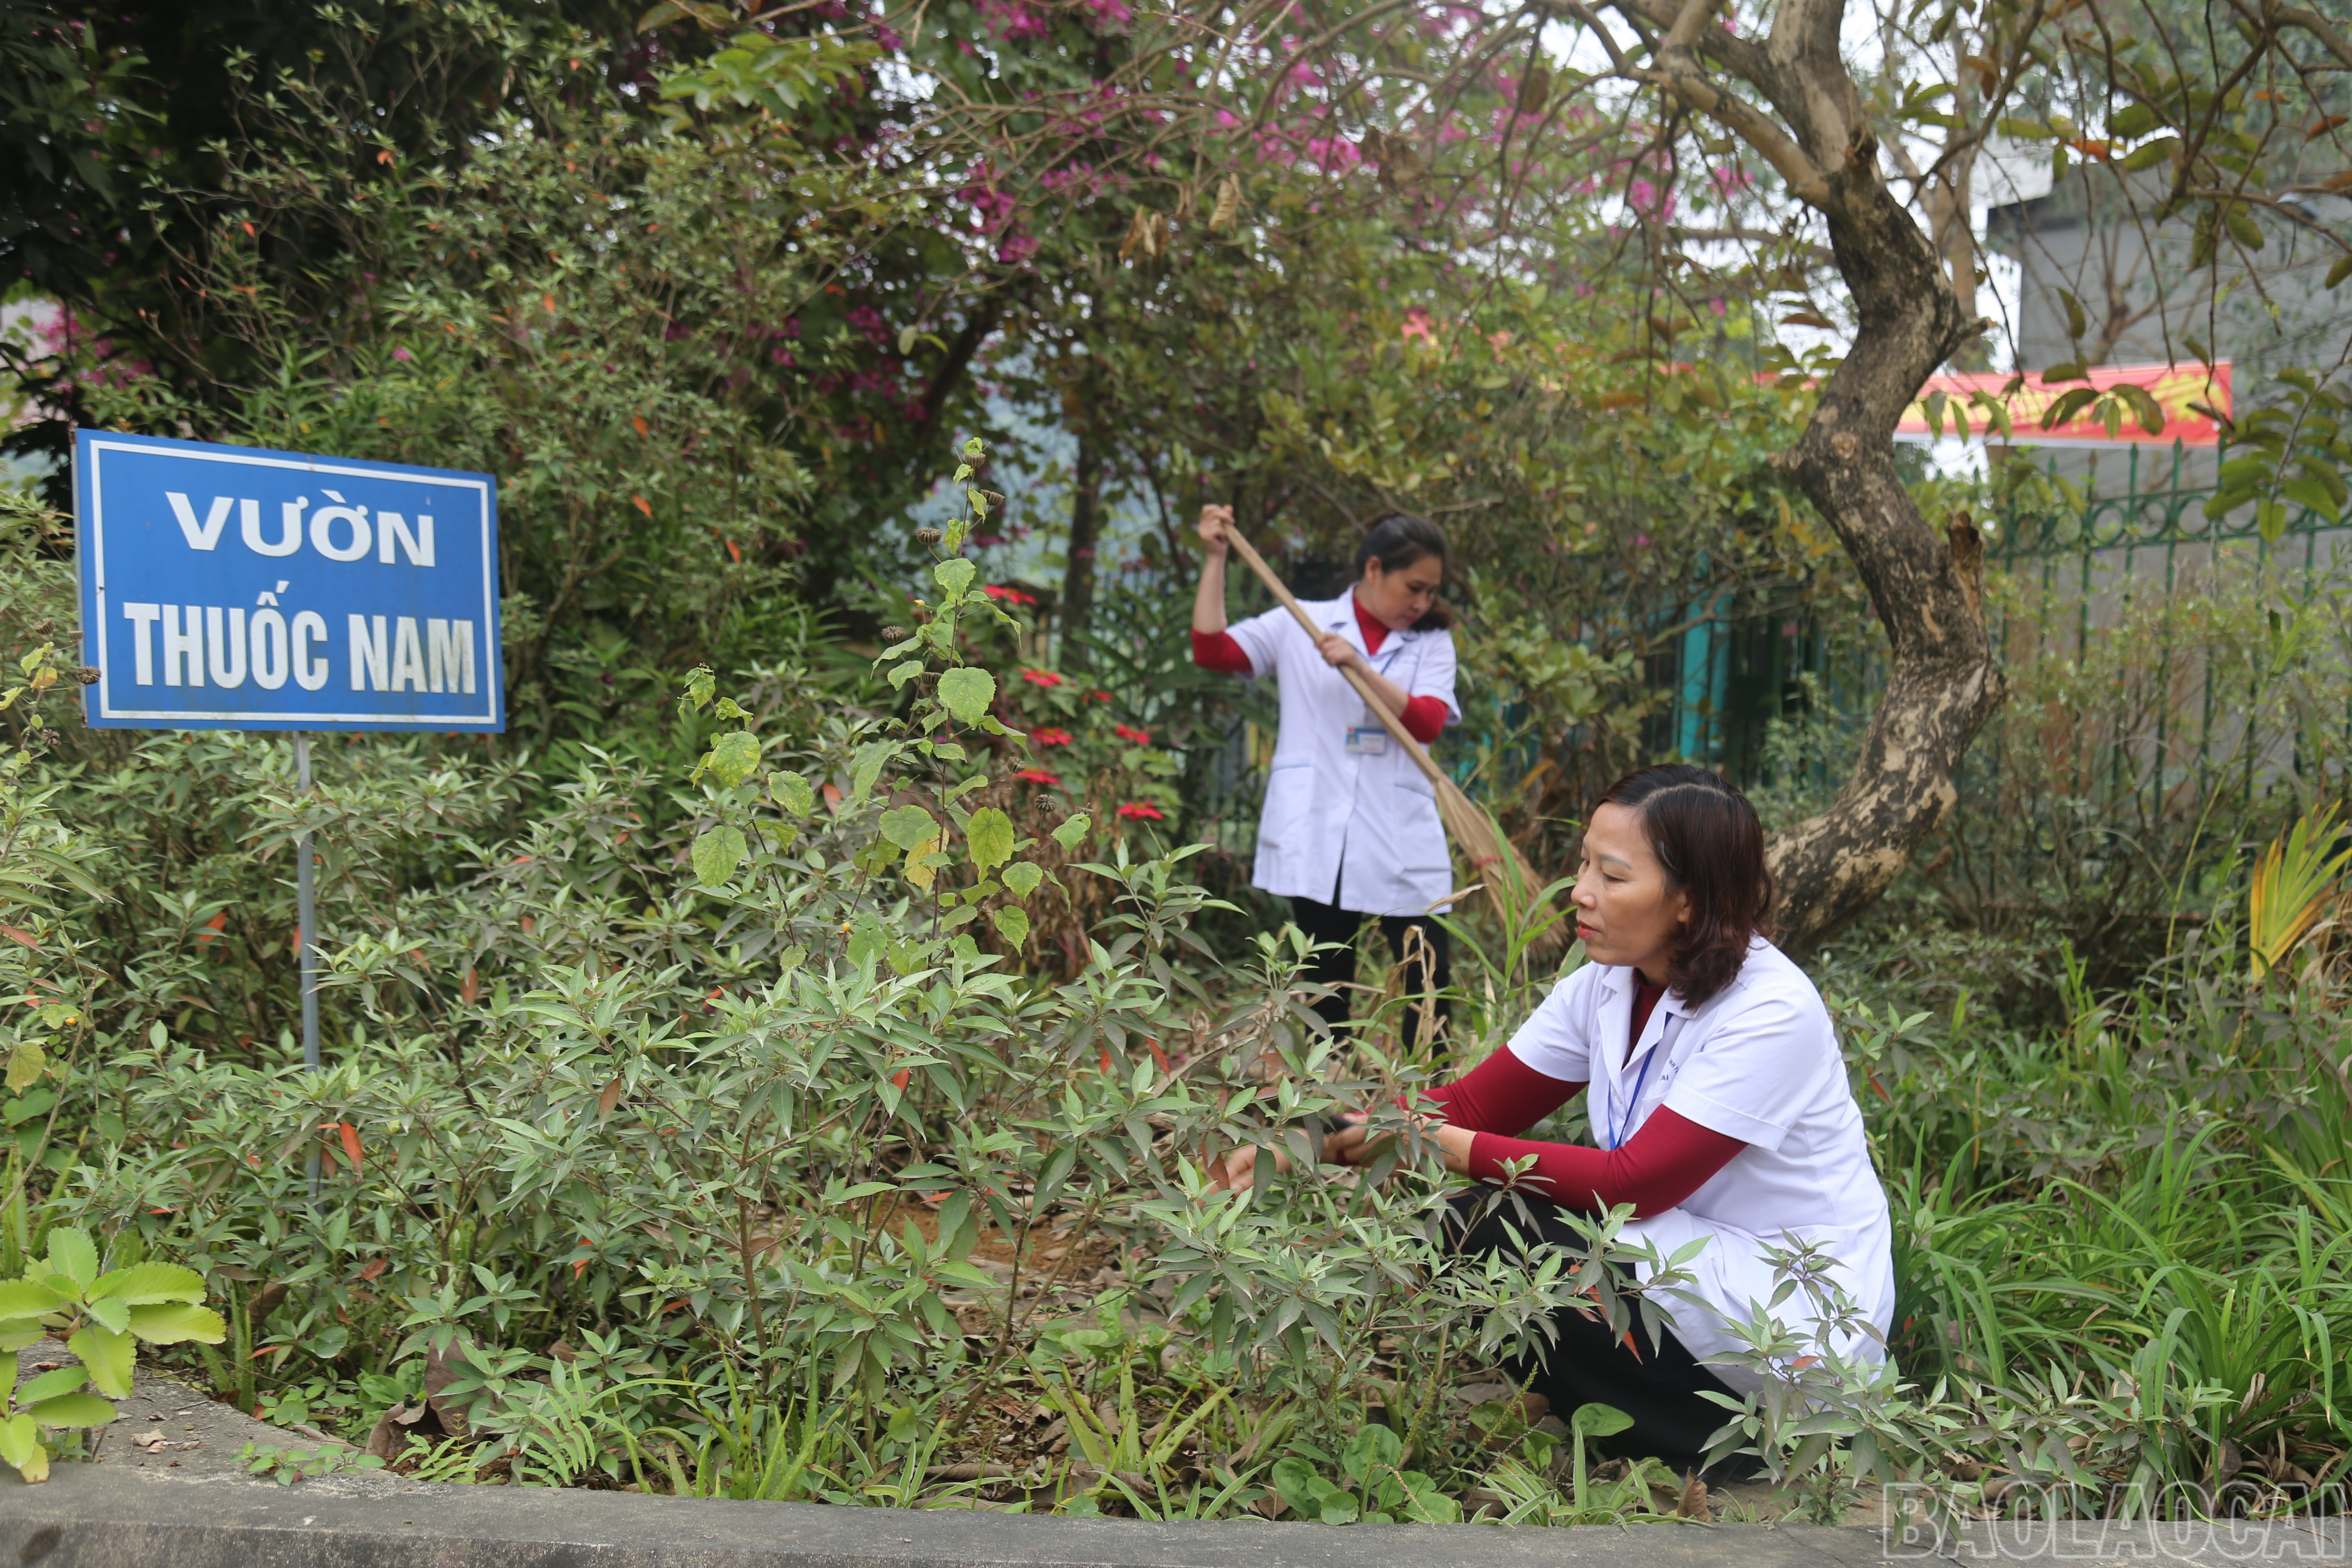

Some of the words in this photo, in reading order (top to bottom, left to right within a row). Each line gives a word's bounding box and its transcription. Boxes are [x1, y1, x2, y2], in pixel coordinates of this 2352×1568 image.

[165, 489, 435, 567] VƯỜN
[123, 580, 329, 691] THUỐC
[348, 614, 476, 694] NAM
